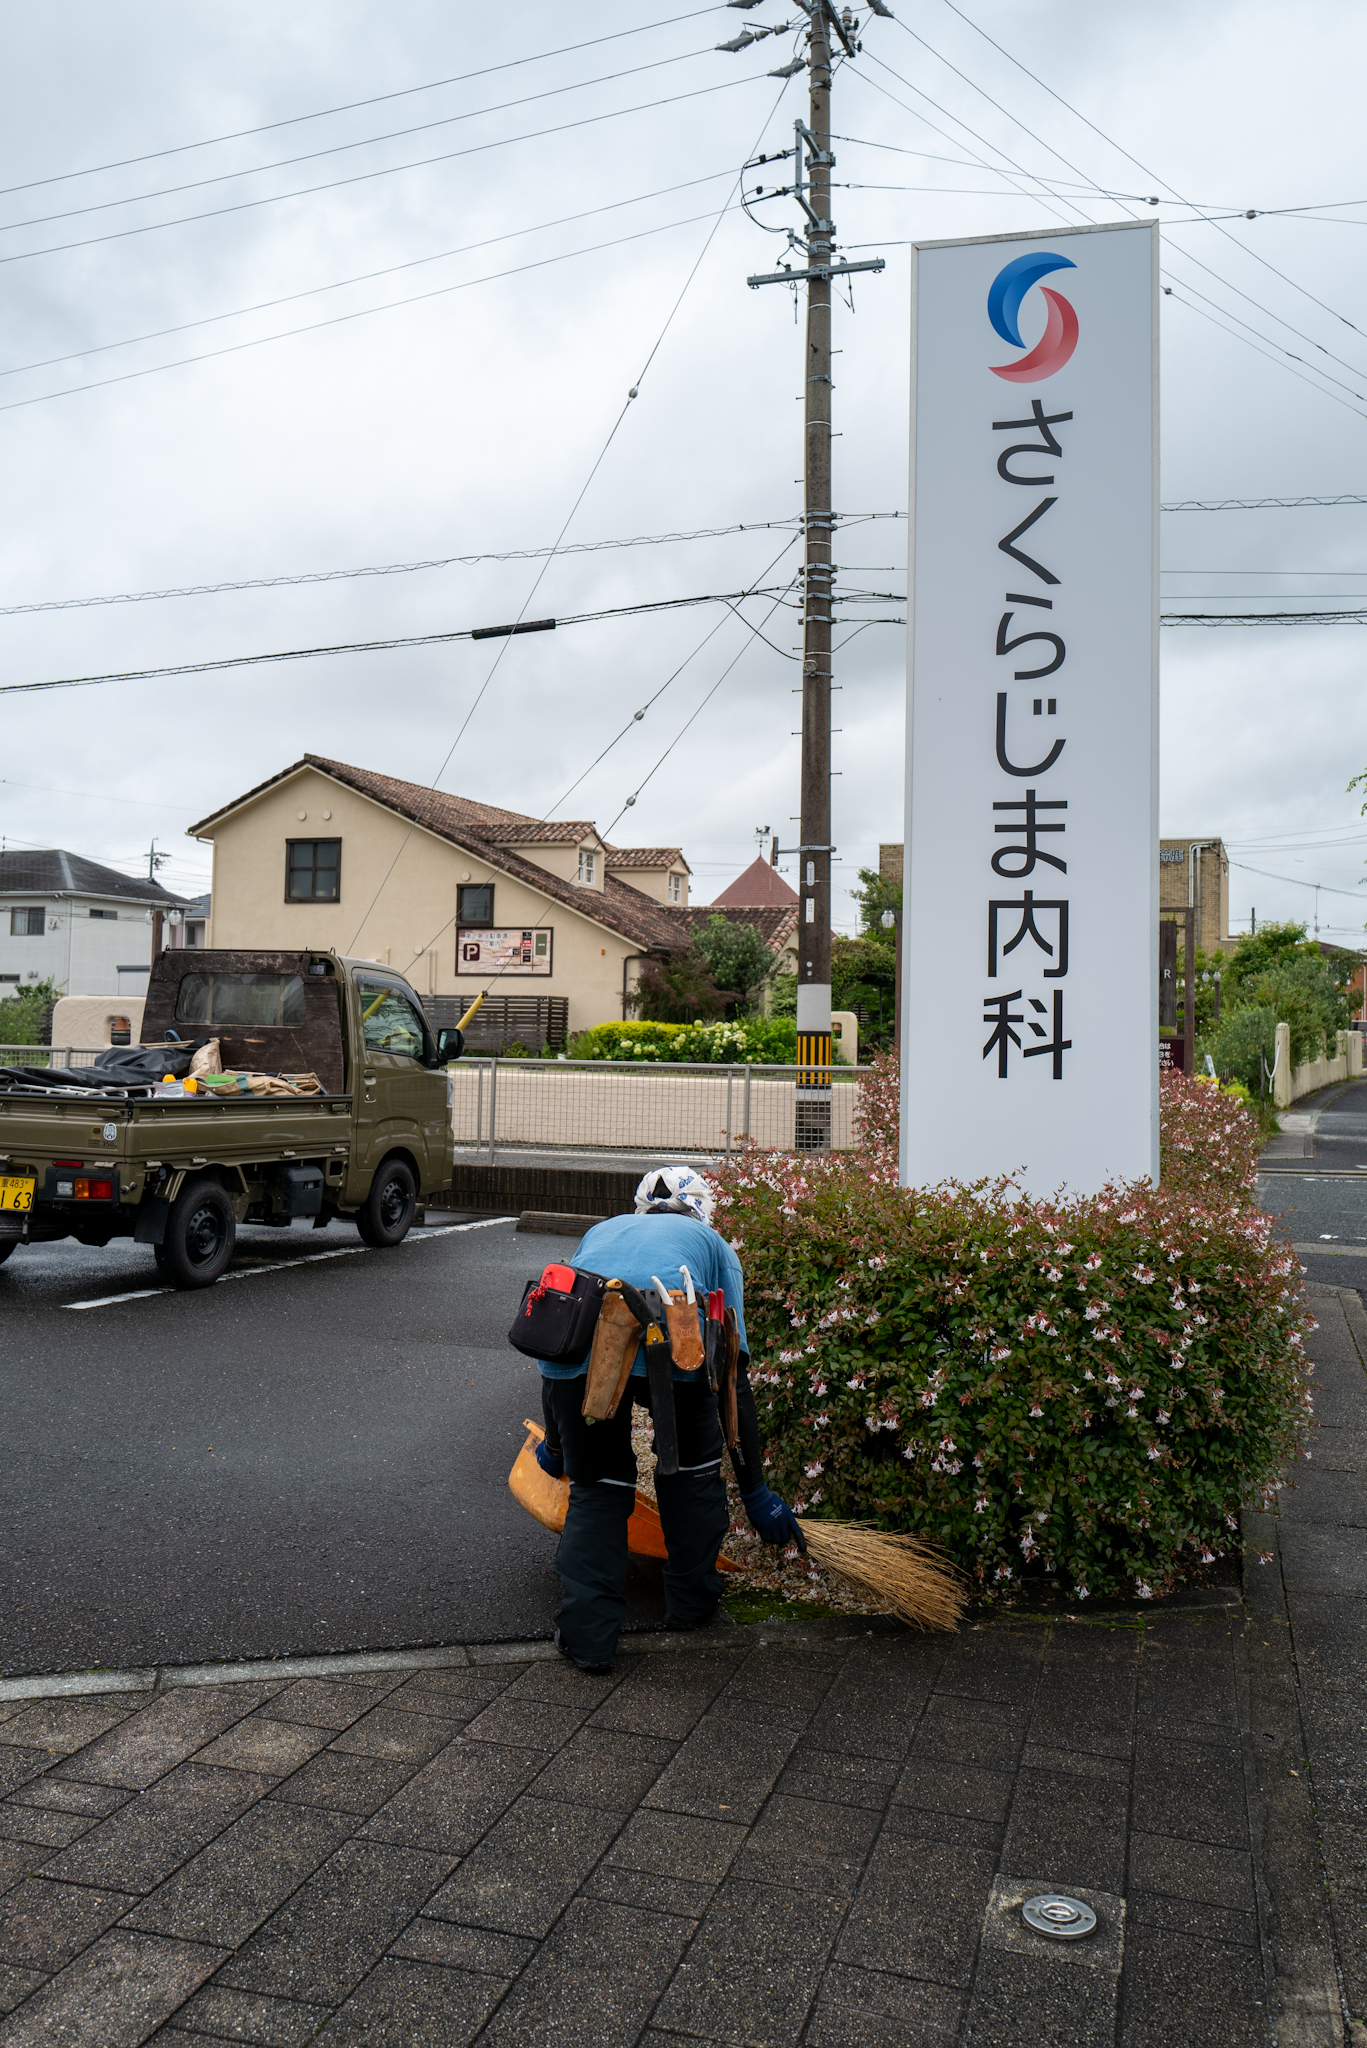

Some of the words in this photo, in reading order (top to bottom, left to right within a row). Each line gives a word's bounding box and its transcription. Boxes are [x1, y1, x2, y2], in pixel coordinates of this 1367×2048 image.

[983, 399, 1074, 1080] さくらじま内科
[466, 944, 479, 960] P
[1164, 968, 1171, 979] R
